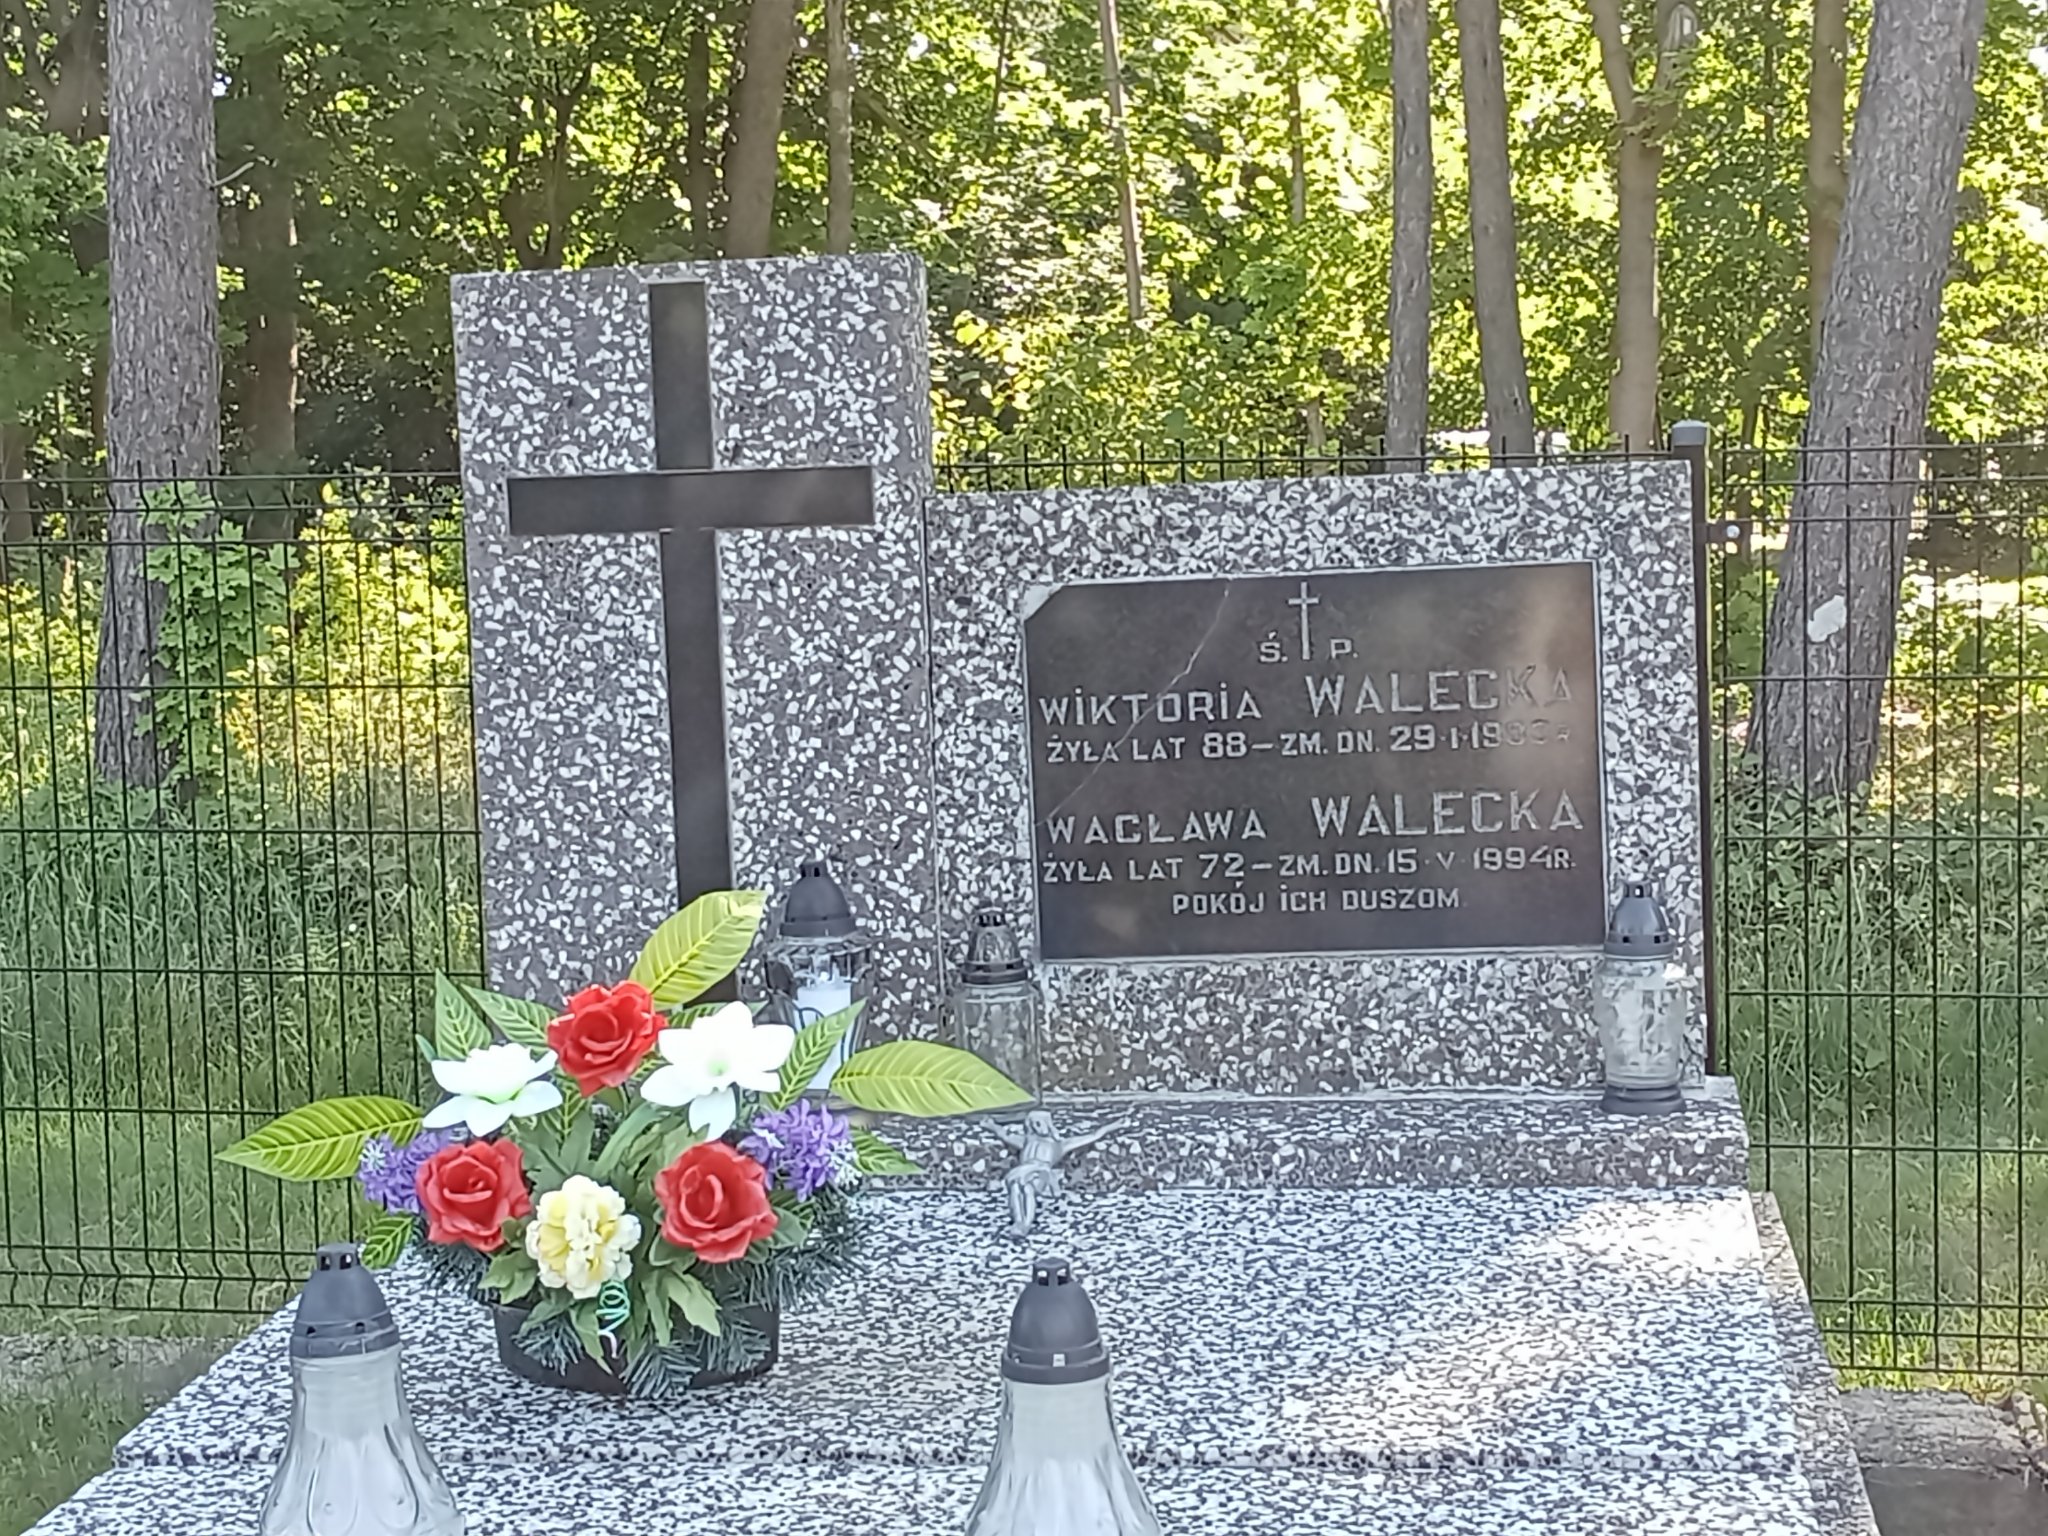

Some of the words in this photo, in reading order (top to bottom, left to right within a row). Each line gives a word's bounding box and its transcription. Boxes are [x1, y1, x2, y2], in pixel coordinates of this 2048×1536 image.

[1259, 630, 1288, 663] Ś.
[1330, 638, 1359, 659] P.
[1305, 664, 1573, 718] WALECKA
[1046, 734, 1120, 764] ŻYŁA
[1132, 736, 1186, 761] LAT
[1202, 732, 1247, 759] 88
[1280, 732, 1329, 756] ZM.
[1337, 729, 1380, 755] DN.
[1047, 808, 1267, 845] WACŁAWA
[1311, 788, 1584, 838] WALECKA
[1043, 852, 1113, 883] ŻYŁA
[1128, 857, 1183, 881] LAT
[1199, 852, 1245, 879] 72
[1278, 854, 1329, 877] ZM.
[1335, 852, 1380, 876] DN.
[1172, 880, 1265, 915] POKÓJ
